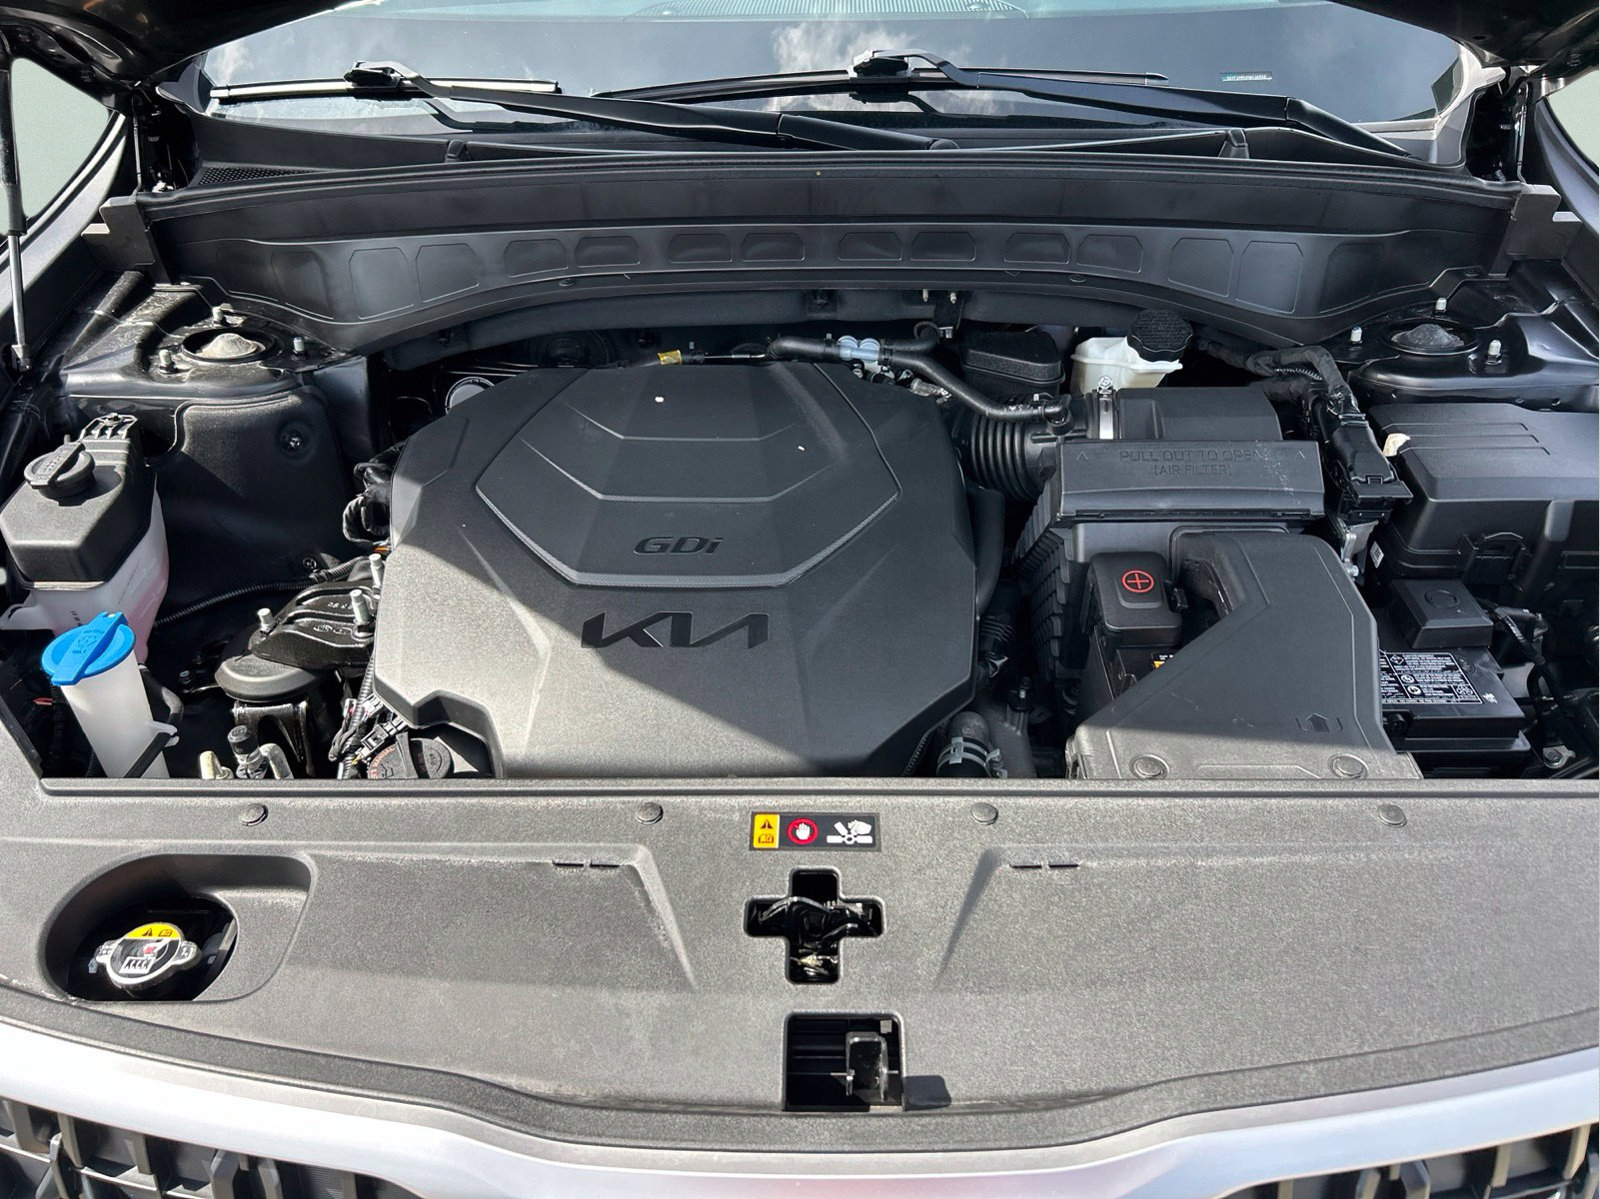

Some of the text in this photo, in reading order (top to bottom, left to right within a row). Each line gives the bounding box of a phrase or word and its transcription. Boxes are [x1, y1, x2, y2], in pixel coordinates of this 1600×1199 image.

[1120, 449, 1159, 461] PULL
[1162, 449, 1194, 461] OUT
[1198, 449, 1218, 461] TO
[633, 536, 724, 555] GDi
[581, 611, 770, 649] KIA
